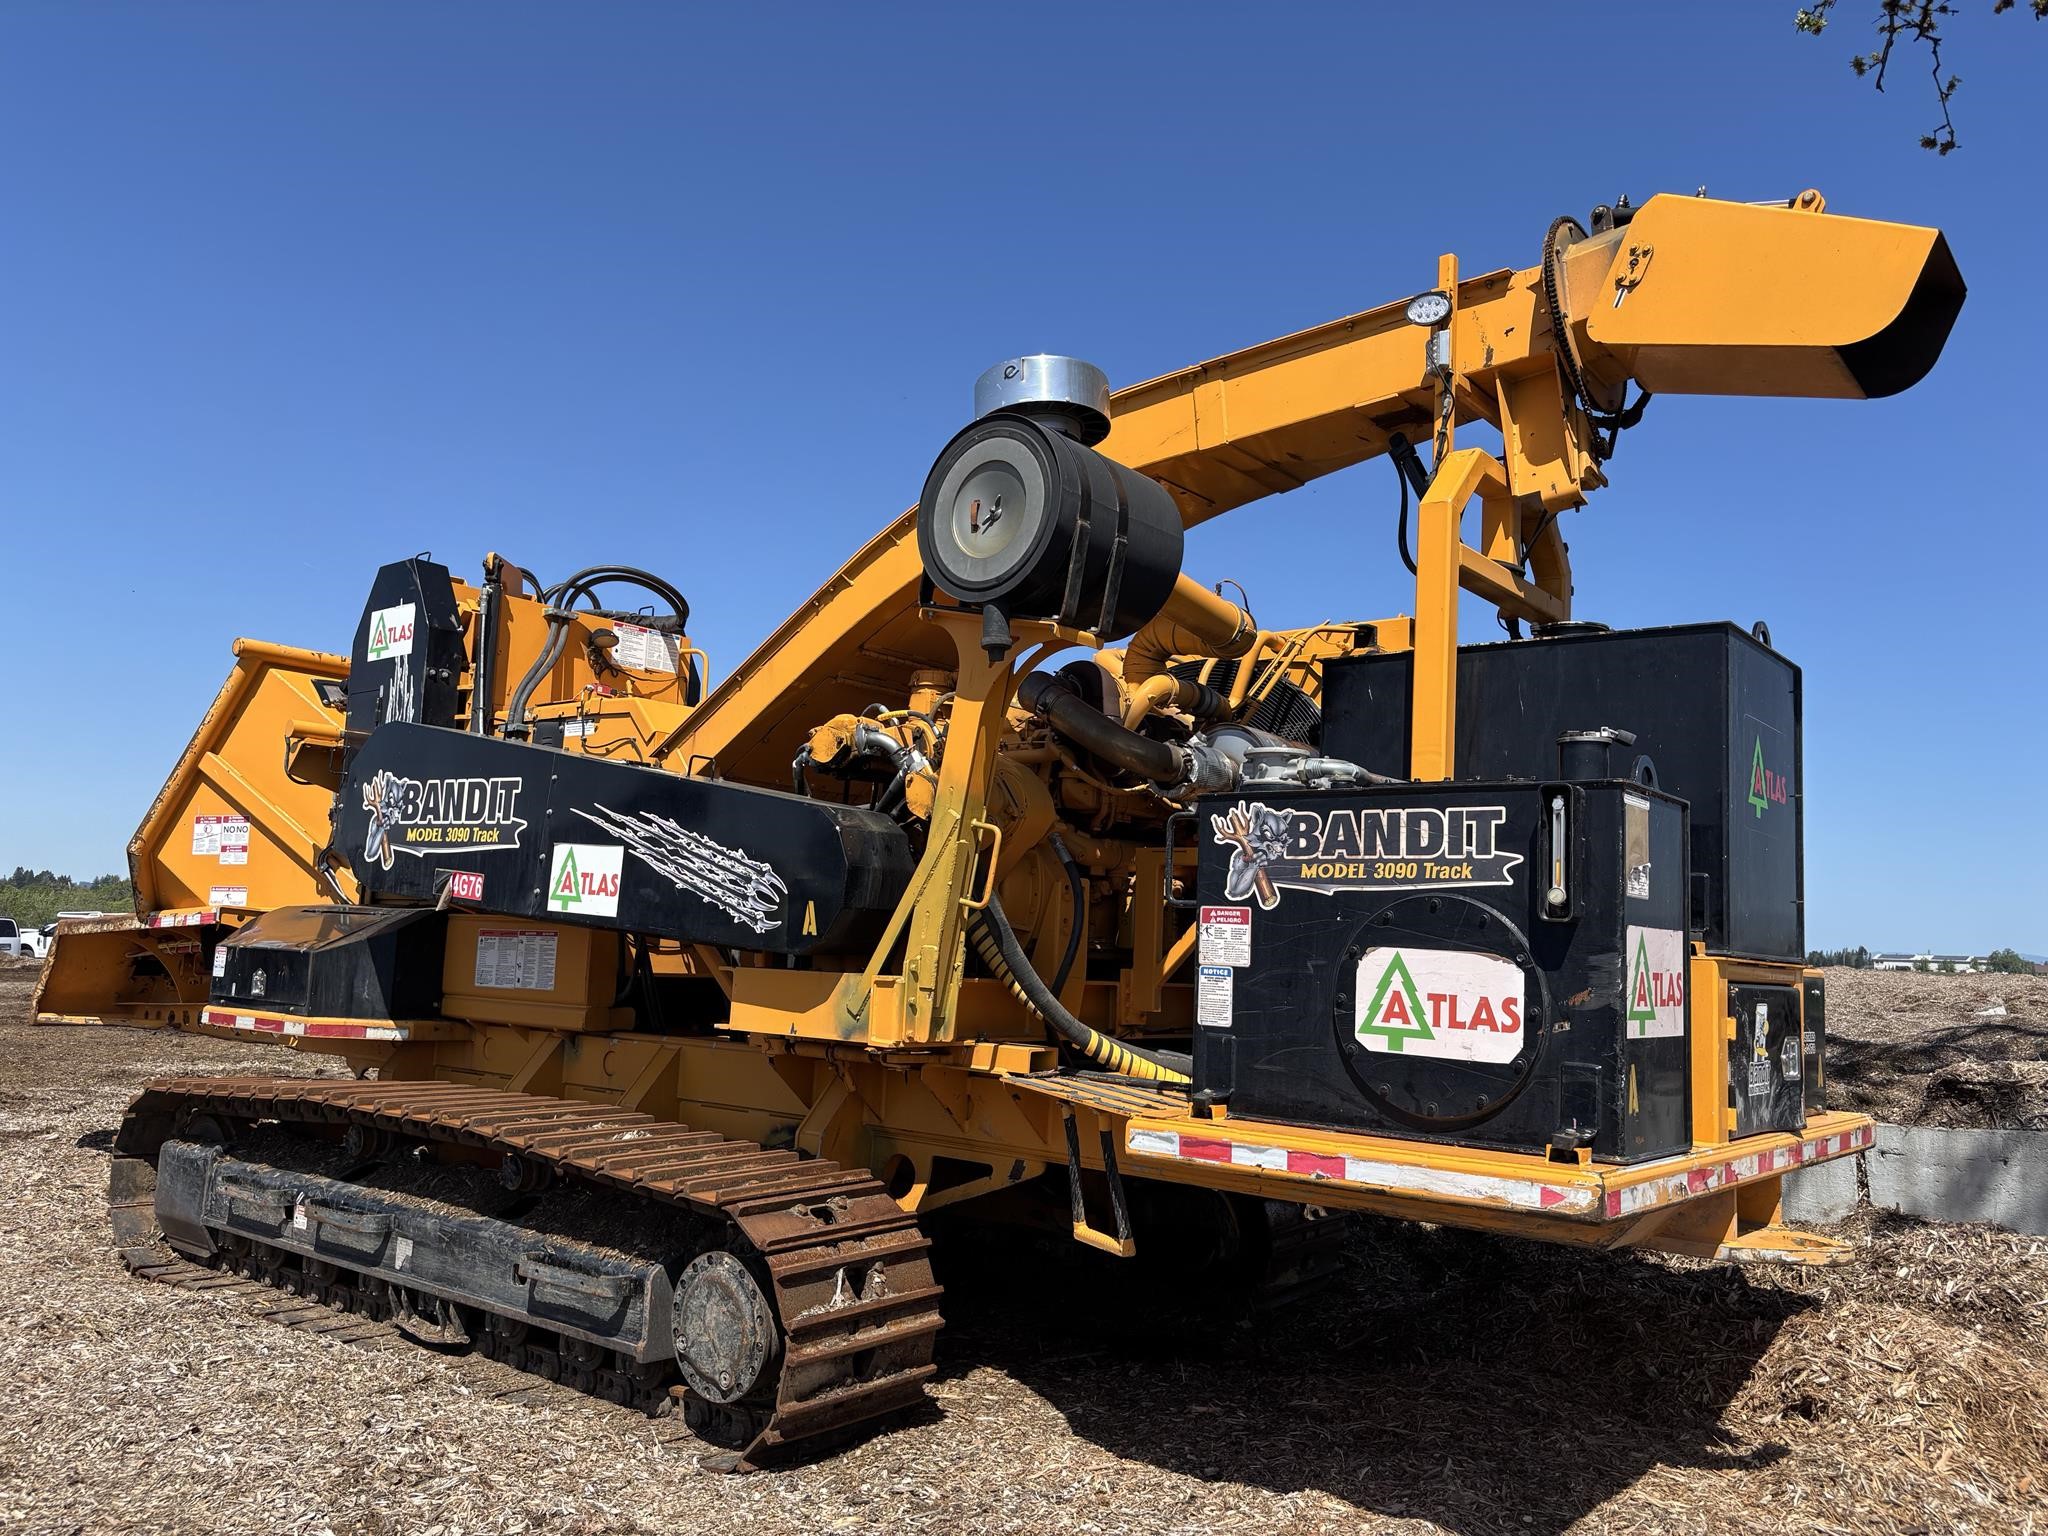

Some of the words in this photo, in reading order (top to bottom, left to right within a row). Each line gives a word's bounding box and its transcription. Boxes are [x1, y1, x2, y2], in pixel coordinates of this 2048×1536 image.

[376, 623, 412, 646] ATLAS
[1755, 766, 1786, 804] ATLAS
[399, 777, 522, 824] BANDIT
[223, 825, 236, 834] NO
[236, 825, 249, 834] NO
[406, 827, 443, 842] MODEL
[445, 827, 470, 843] 3090
[472, 827, 500, 843] Track
[1284, 806, 1506, 859] BANDIT
[1300, 863, 1367, 879] MODEL
[1373, 862, 1417, 879] 3090
[1424, 862, 1473, 879] Track
[560, 871, 619, 897] ATLAS
[1203, 968, 1229, 976] NOTICE
[1636, 971, 1683, 1008] ATLAS
[1381, 990, 1521, 1033] ATLAS
